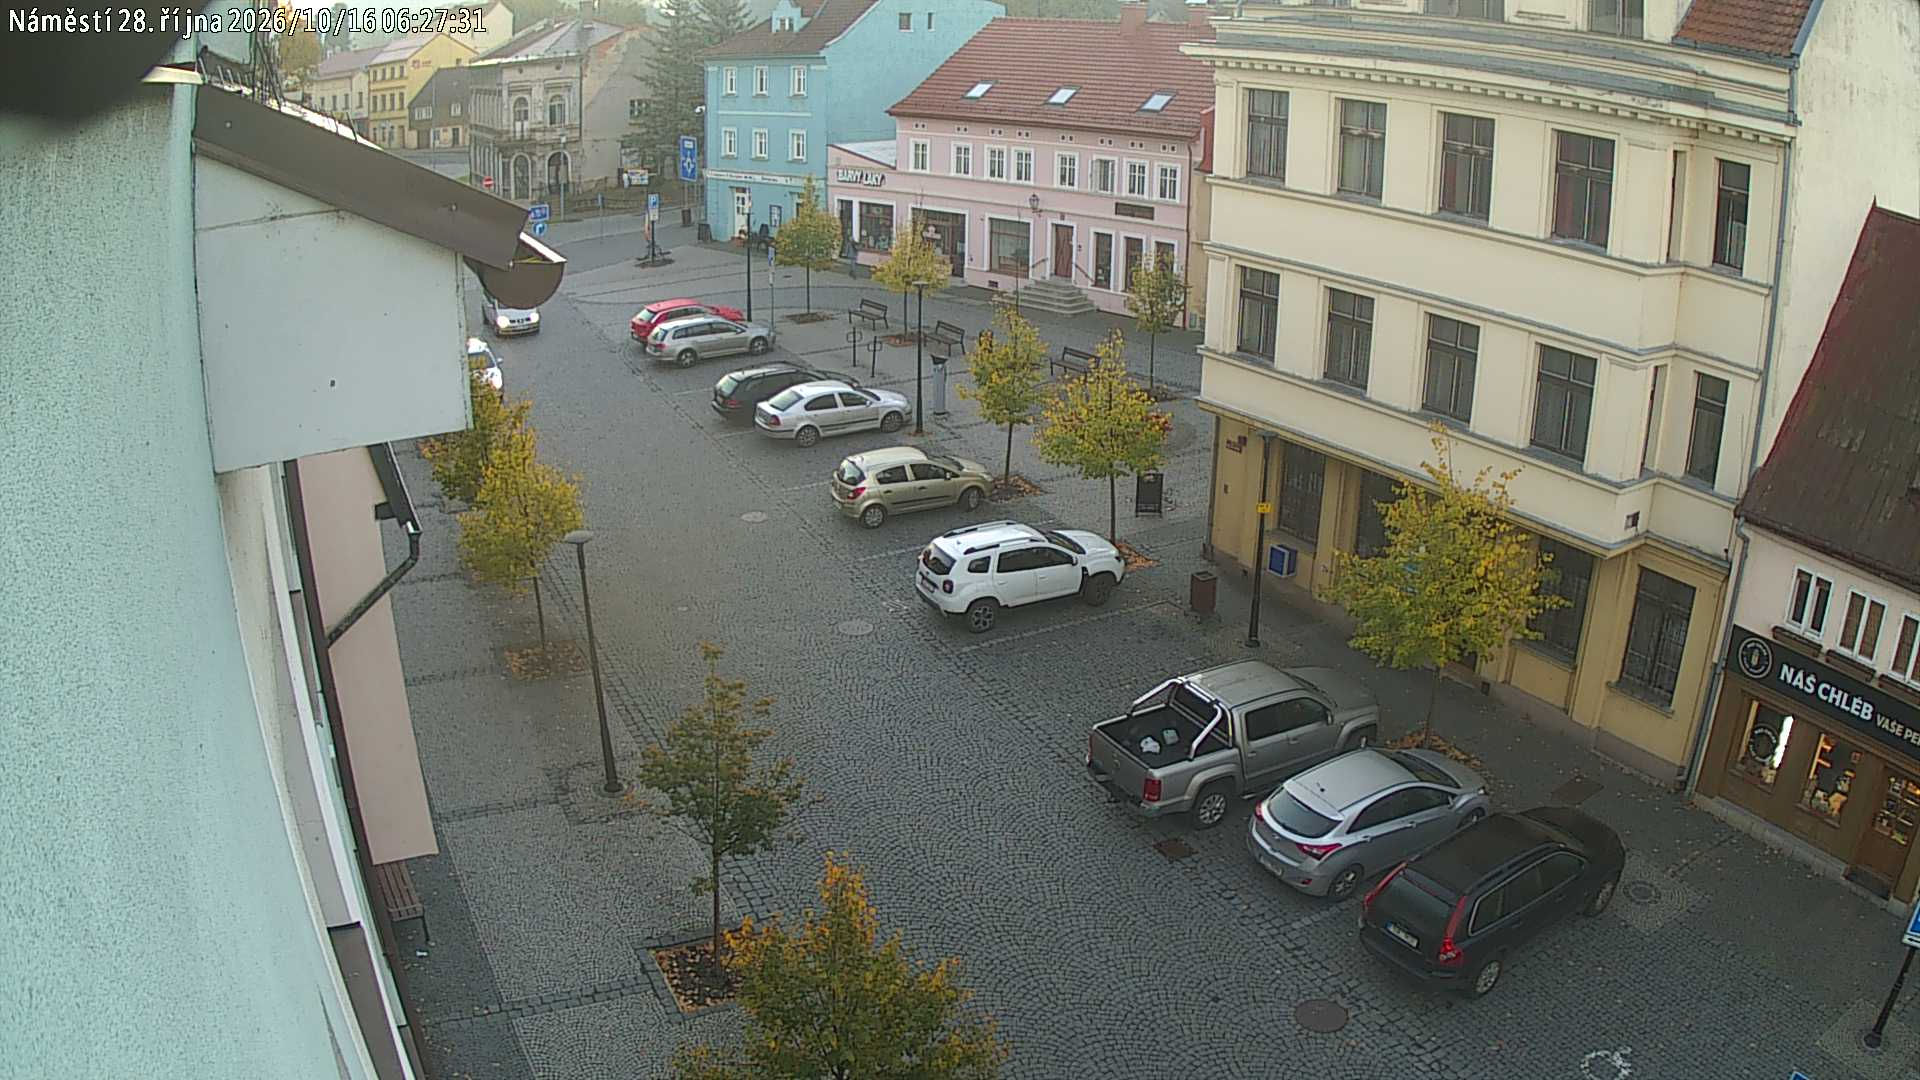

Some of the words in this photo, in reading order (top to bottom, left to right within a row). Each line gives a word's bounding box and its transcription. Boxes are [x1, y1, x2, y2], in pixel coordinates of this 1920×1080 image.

[1779, 663, 1817, 694] NÁŠ
[1817, 683, 1874, 721] CHLÉB
[1903, 727, 1920, 746] PE
